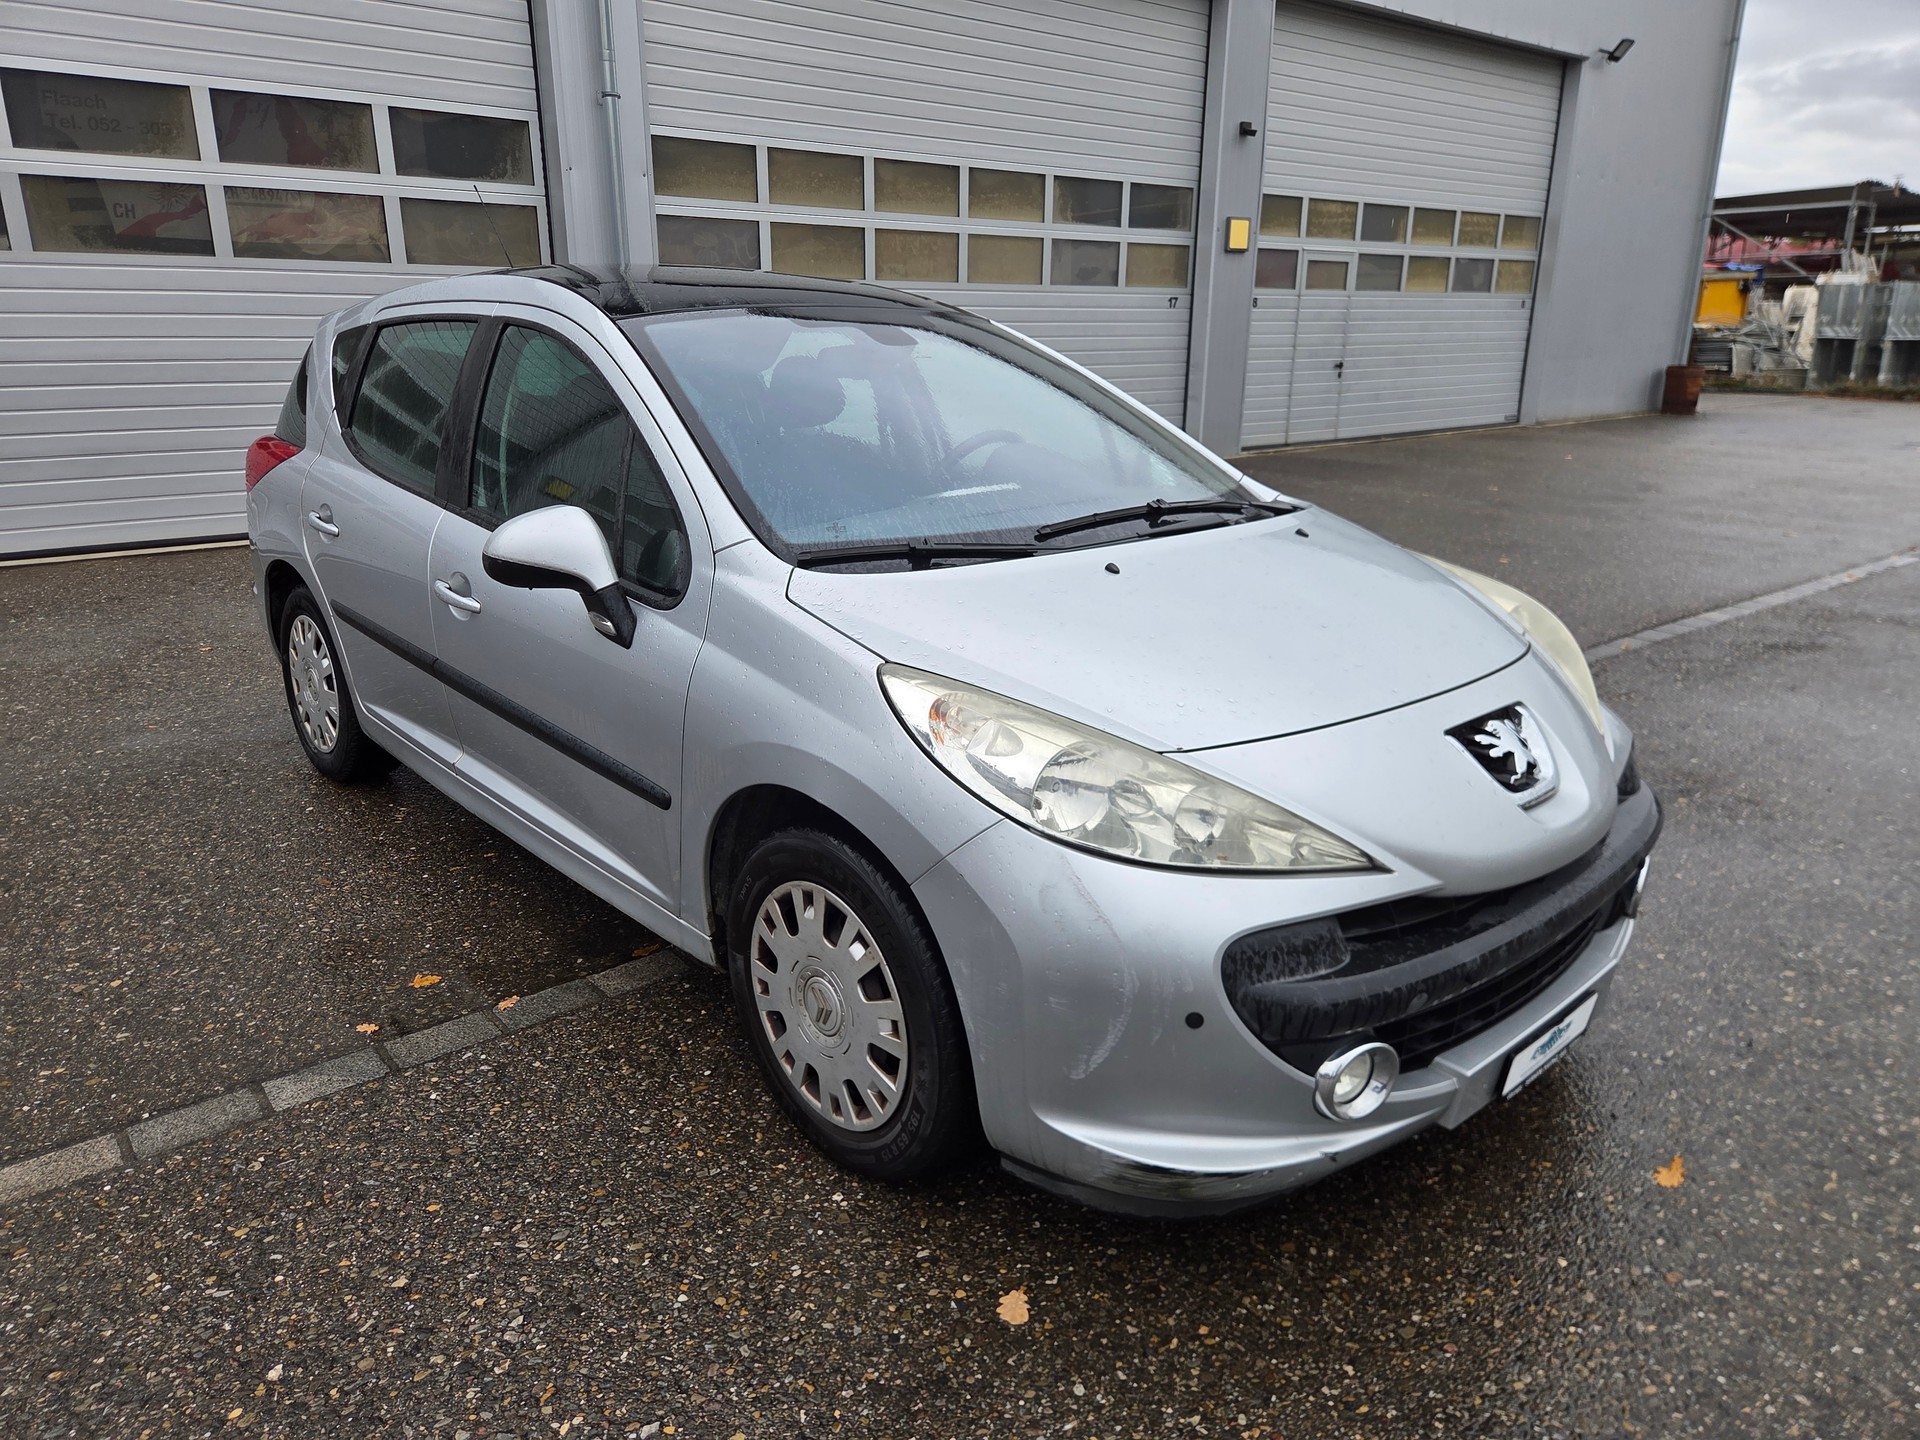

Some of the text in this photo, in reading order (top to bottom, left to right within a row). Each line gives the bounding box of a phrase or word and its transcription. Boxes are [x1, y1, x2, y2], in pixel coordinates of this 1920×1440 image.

[40, 89, 108, 110] Flaach
[45, 112, 82, 130] Tel.
[87, 116, 122, 133] 052
[112, 202, 136, 219] CH
[1168, 297, 1179, 309] 17
[897, 1110, 921, 1150] 195/65
